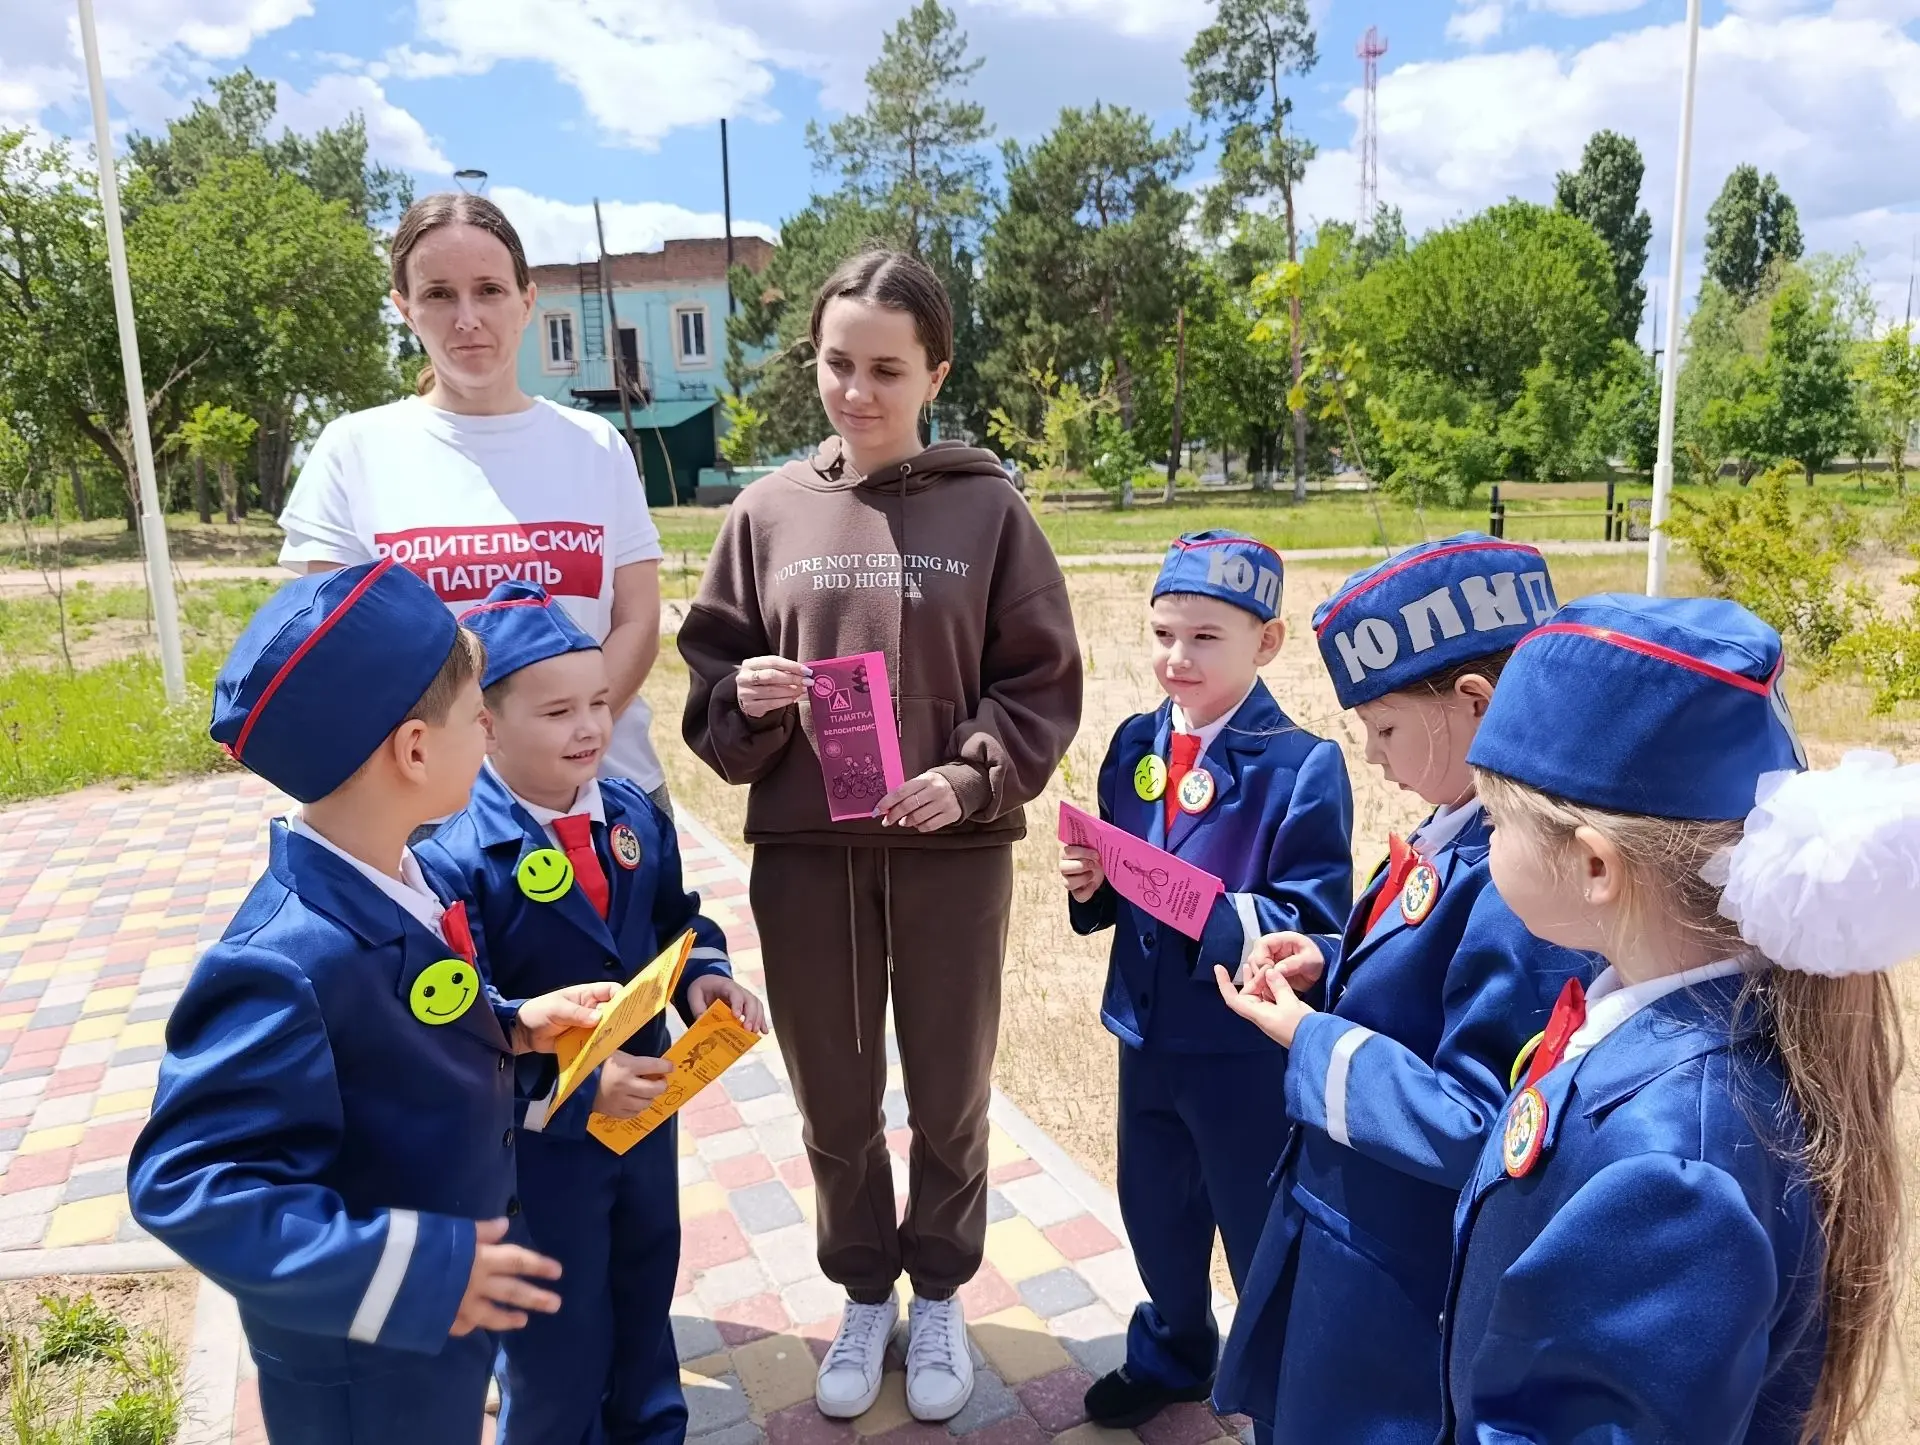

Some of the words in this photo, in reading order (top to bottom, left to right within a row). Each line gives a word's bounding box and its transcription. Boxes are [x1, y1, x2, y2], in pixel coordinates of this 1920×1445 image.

[375, 529, 603, 564] РОДИТЕЛЬСКИЙ
[774, 557, 823, 585] YOU'RE
[825, 554, 862, 570] NOT
[866, 553, 943, 571] GETTING
[946, 559, 970, 578] MY
[812, 573, 851, 590] BUD
[1207, 551, 1283, 618] ЮП
[829, 711, 873, 724] ПАМЯТКА
